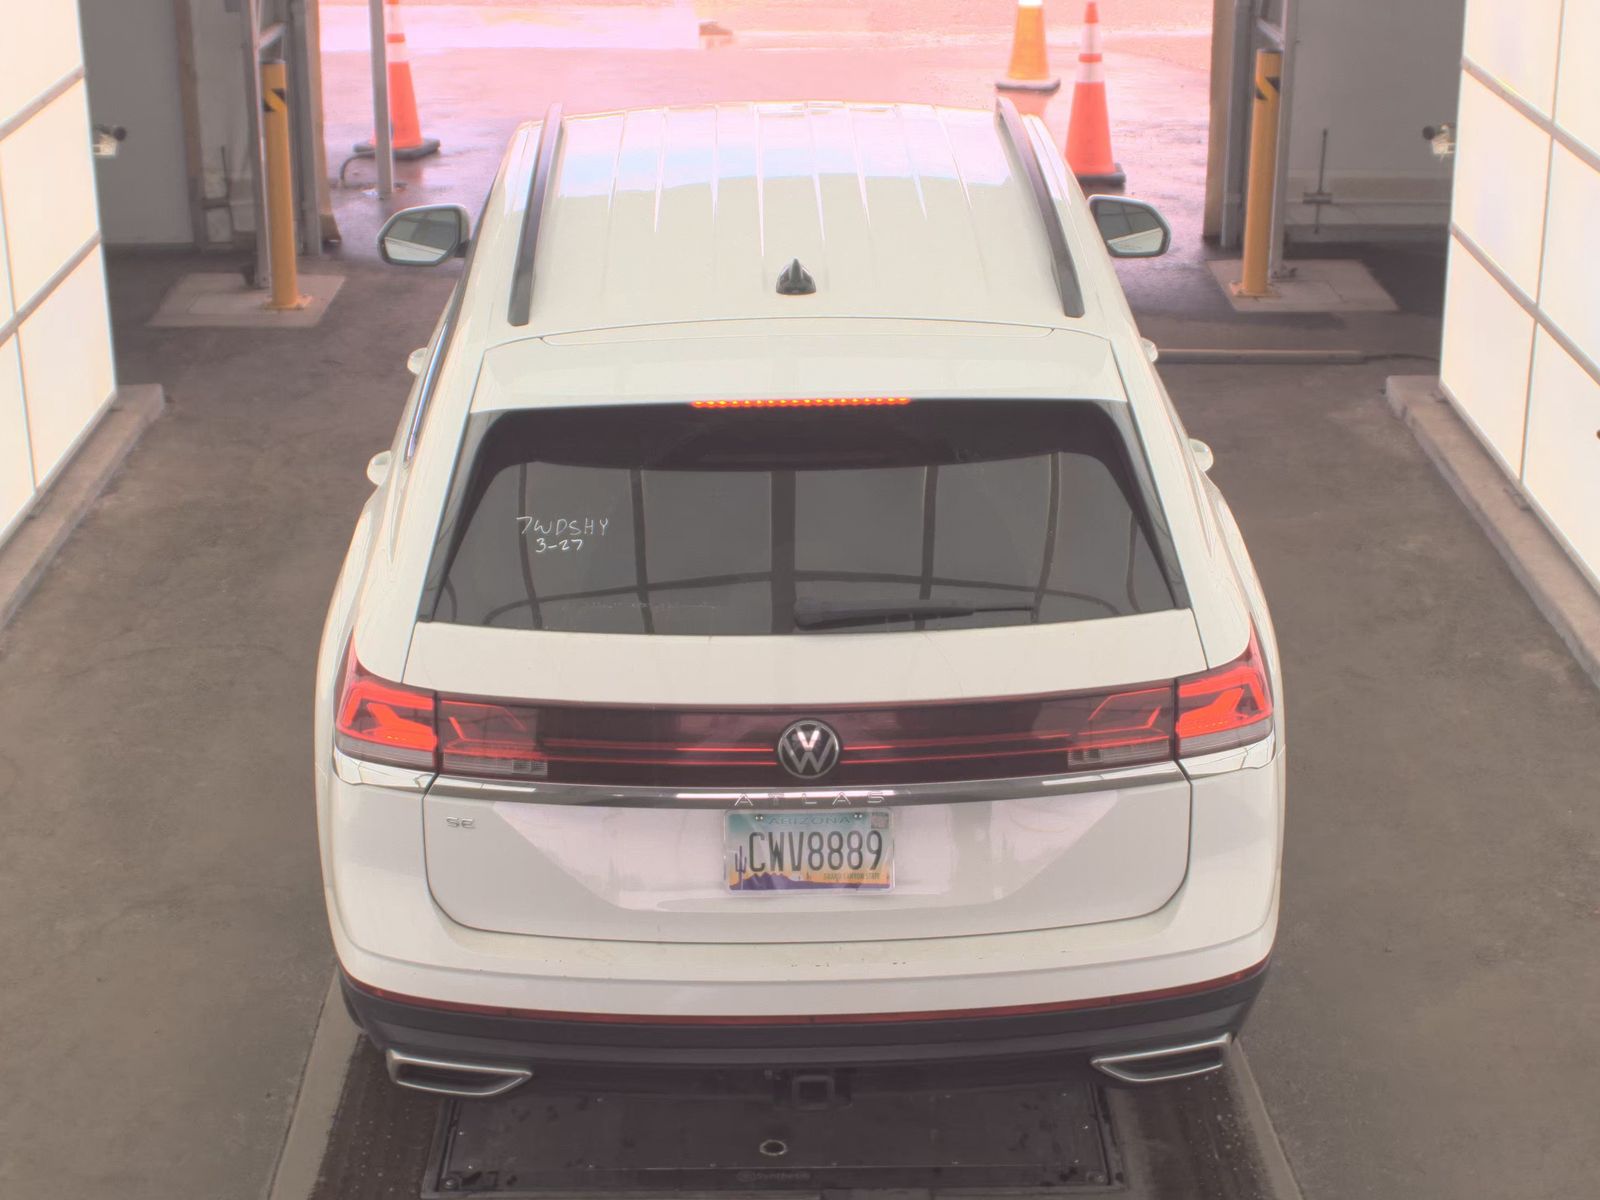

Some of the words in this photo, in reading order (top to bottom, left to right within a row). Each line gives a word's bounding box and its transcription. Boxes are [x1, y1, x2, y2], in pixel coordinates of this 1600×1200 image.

[536, 538, 583, 552] 3-27
[734, 792, 885, 806] ATLAS
[446, 816, 475, 828] SE
[768, 816, 850, 825] ARIZONA
[749, 831, 883, 872] CWV8889
